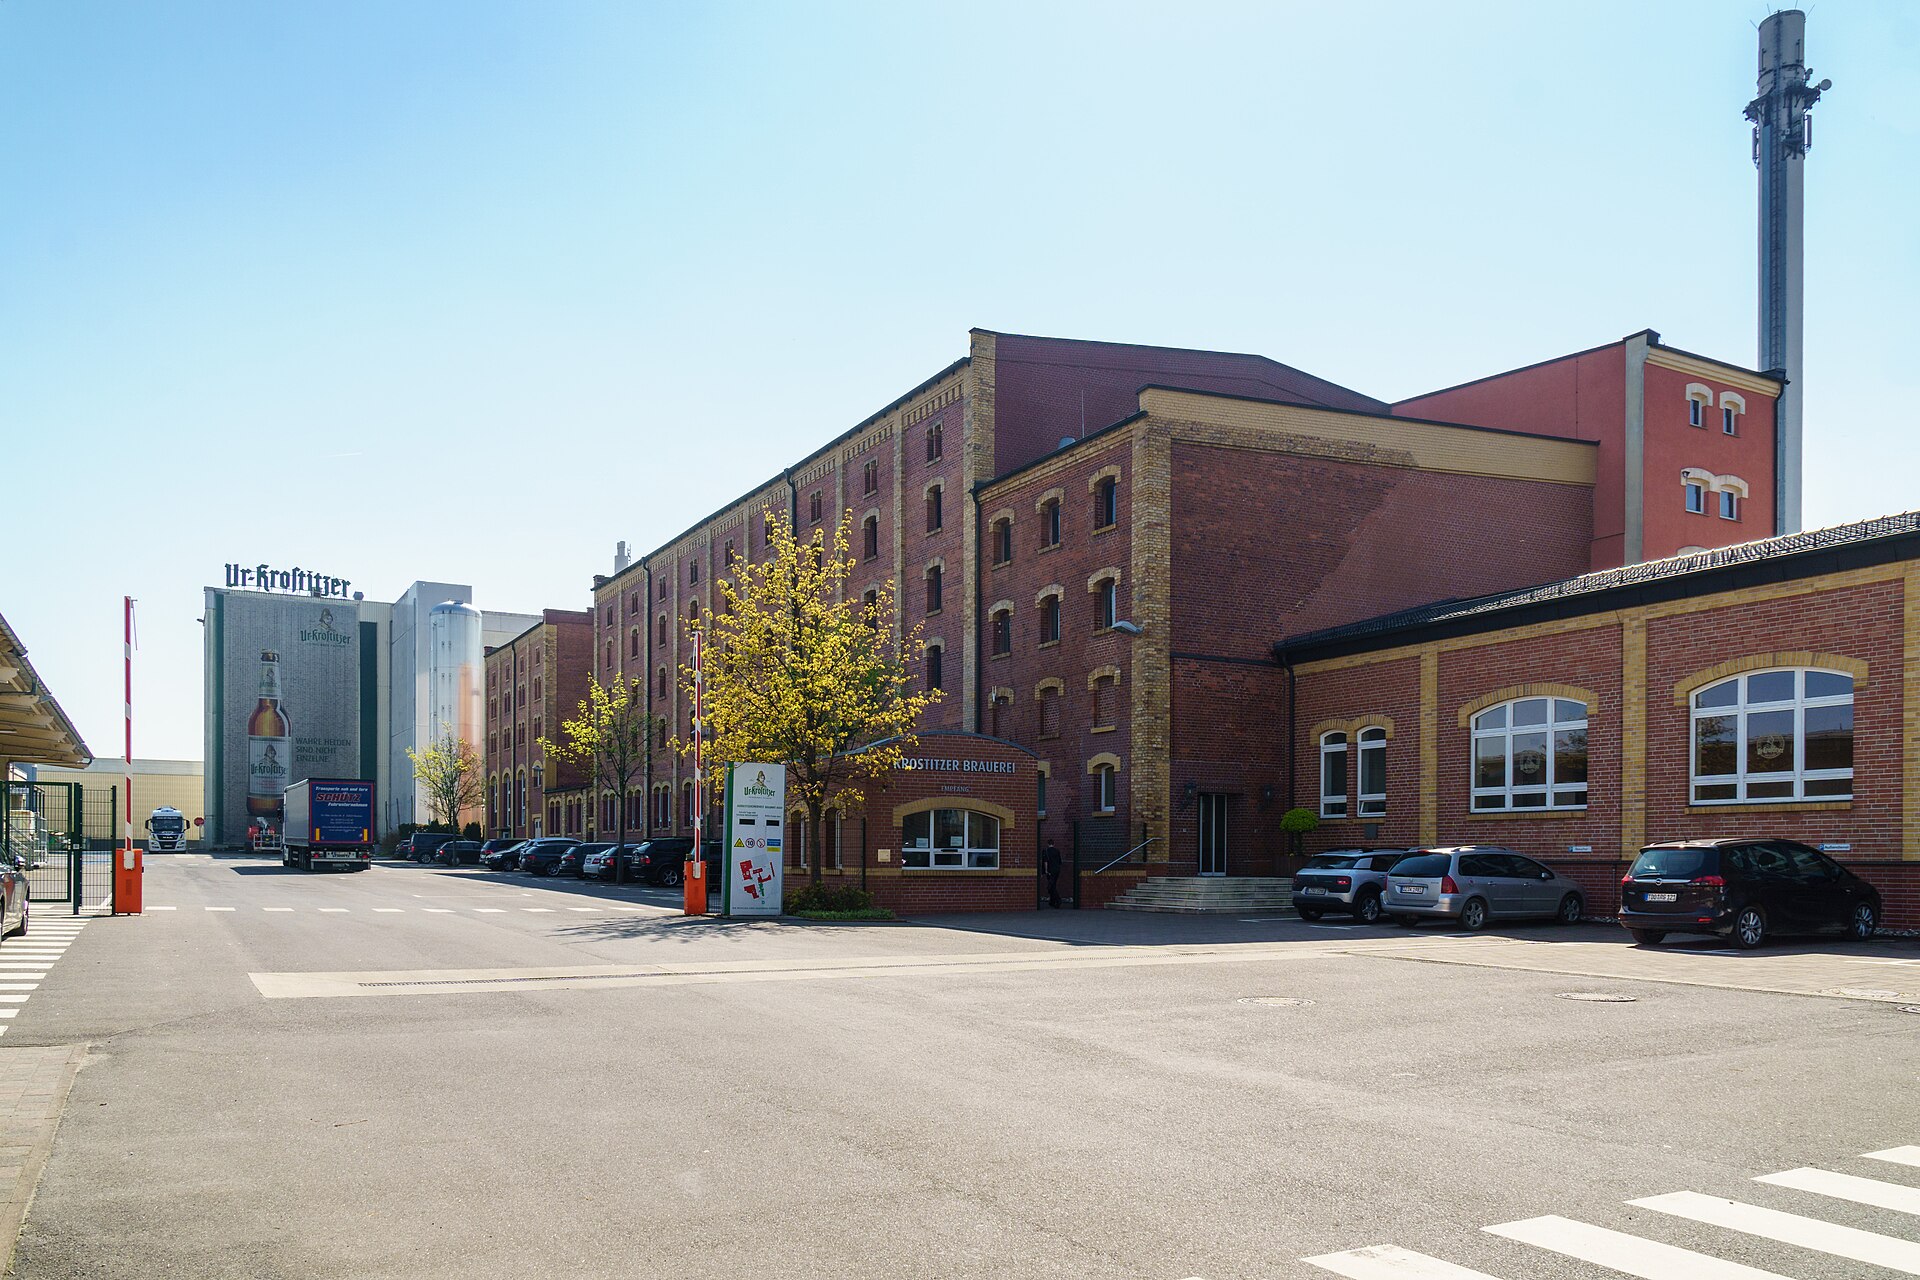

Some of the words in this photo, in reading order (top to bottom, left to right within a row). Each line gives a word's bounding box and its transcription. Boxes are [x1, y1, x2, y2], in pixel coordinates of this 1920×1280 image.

[295, 737, 322, 746] WAHRE
[324, 738, 352, 747] HELDEN
[296, 746, 314, 754] SIND
[315, 747, 337, 755] NICHT
[893, 758, 959, 771] KROSTITZER
[963, 760, 1016, 773] BRAUEREI
[941, 785, 970, 793] EMPFANG
[316, 792, 361, 802] SCHÜTZ
